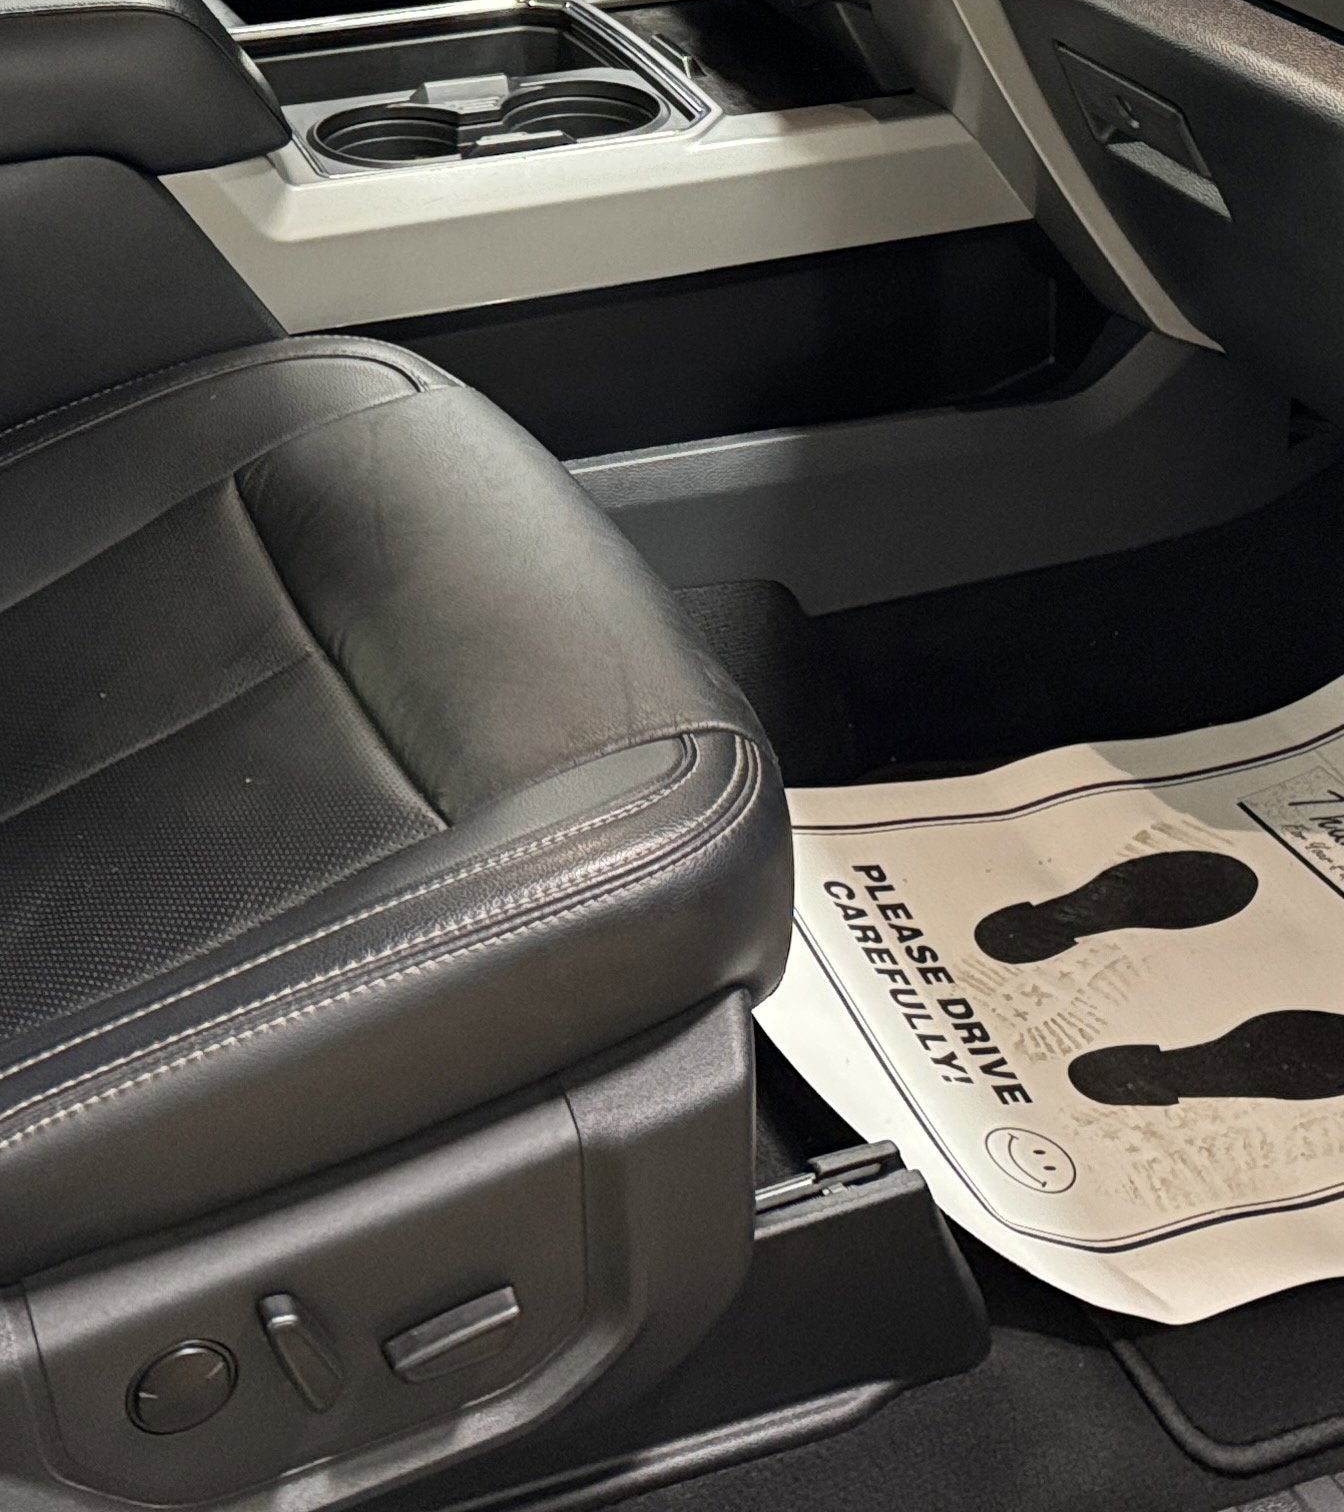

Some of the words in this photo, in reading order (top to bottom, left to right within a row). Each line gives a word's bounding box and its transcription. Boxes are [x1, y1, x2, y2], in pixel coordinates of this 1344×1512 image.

[823, 880, 975, 1085] CAREFULLY!
[851, 864, 956, 986] PLEASE
[936, 997, 1034, 1106] DRIVE
